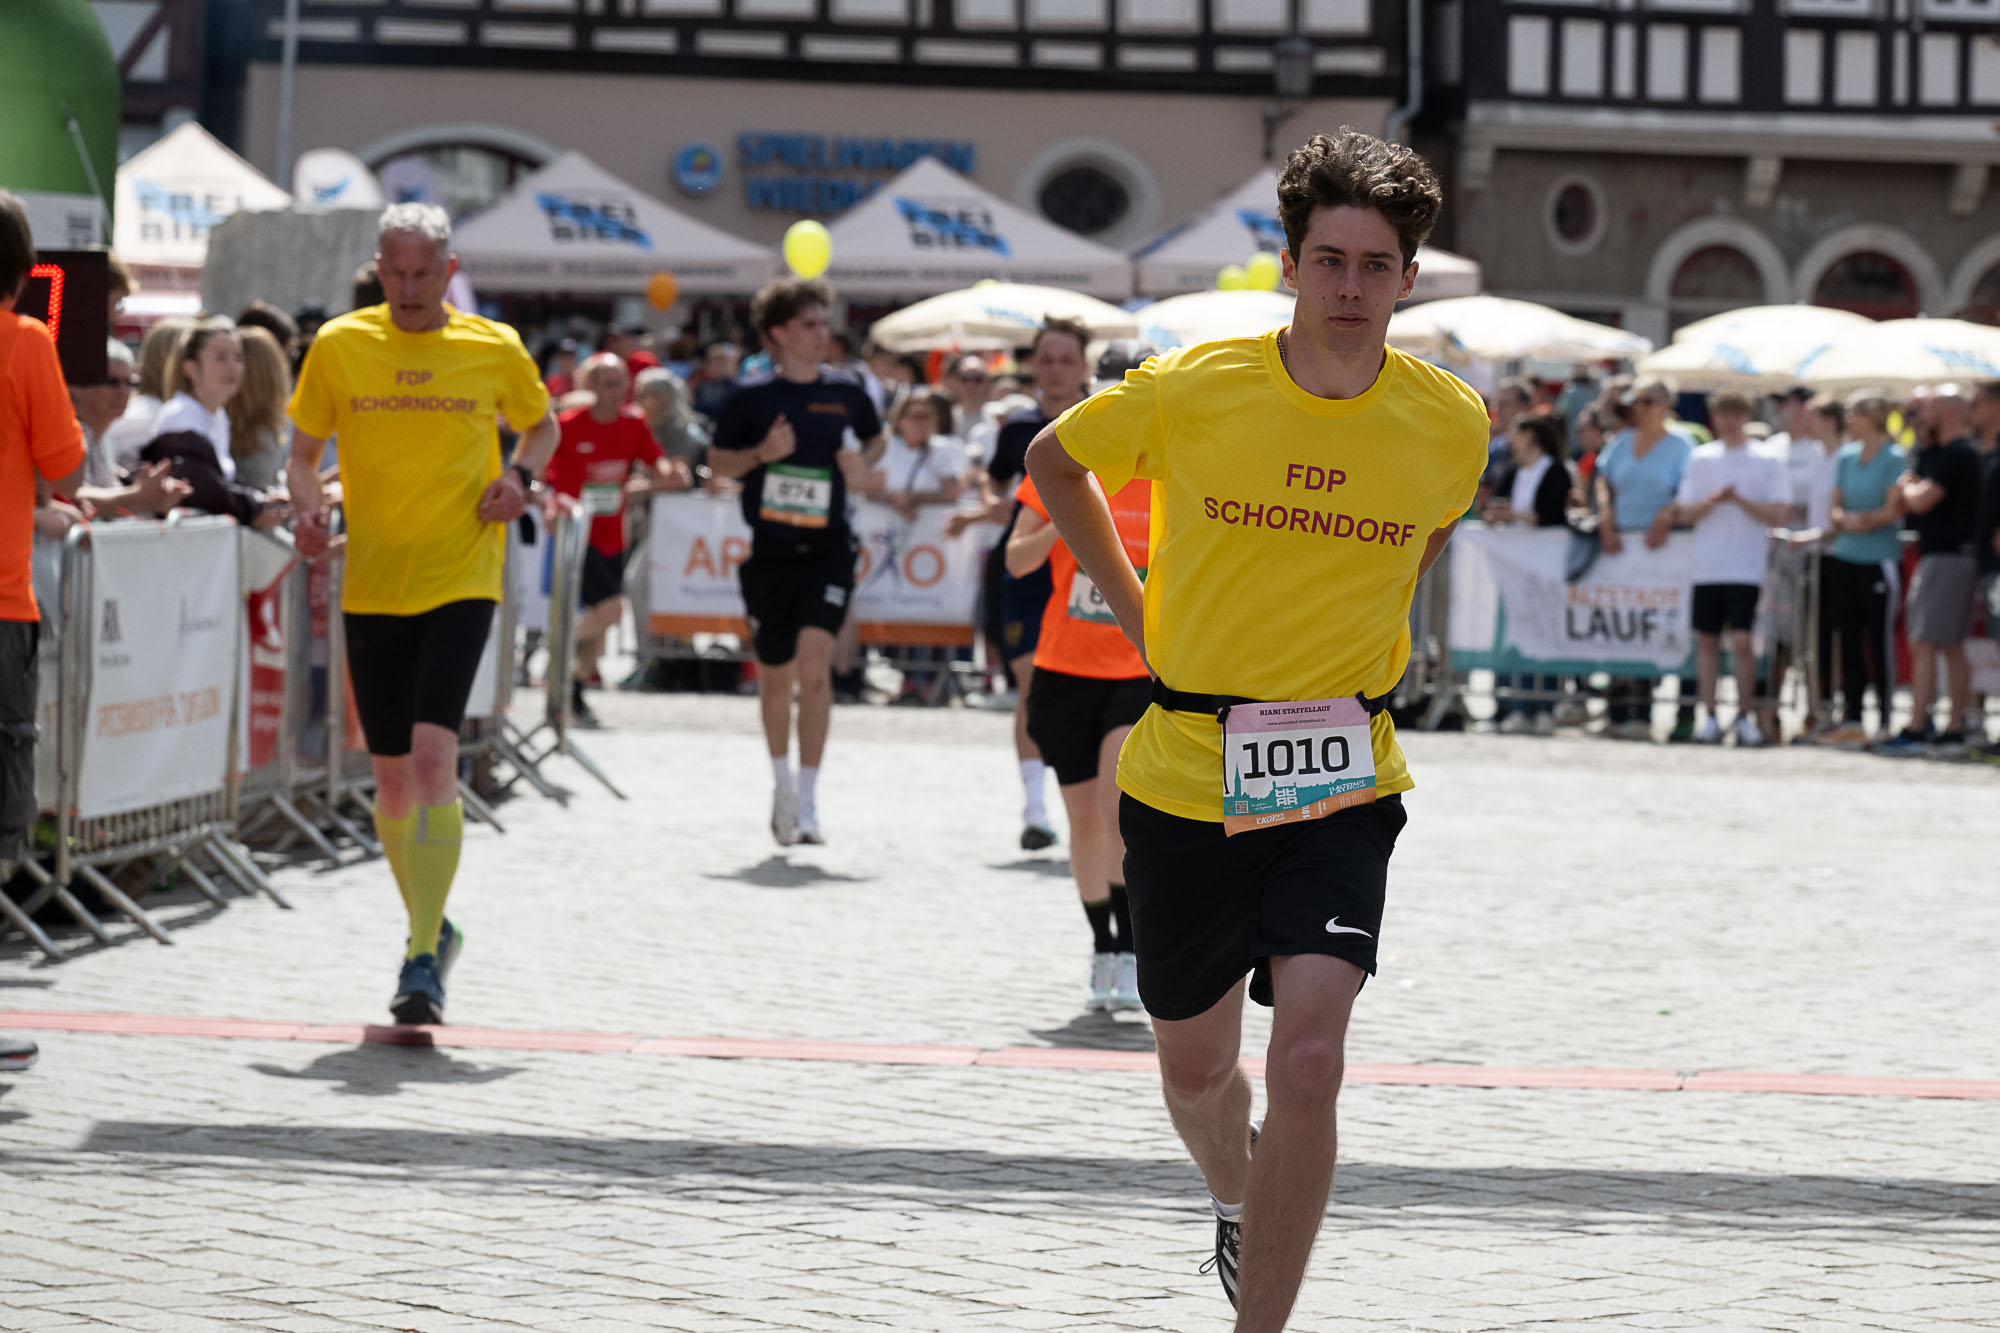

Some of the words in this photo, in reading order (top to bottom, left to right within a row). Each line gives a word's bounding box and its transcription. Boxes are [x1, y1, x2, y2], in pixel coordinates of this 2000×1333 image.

[395, 369, 434, 386] FDP
[350, 395, 478, 414] SCHORNDORF
[1286, 463, 1347, 493] FDP
[1204, 497, 1416, 547] SCHORNDORF
[1566, 608, 1657, 643] LAUF
[1282, 706, 1331, 715] STAFFELLAUF
[1242, 735, 1350, 780] 1010
